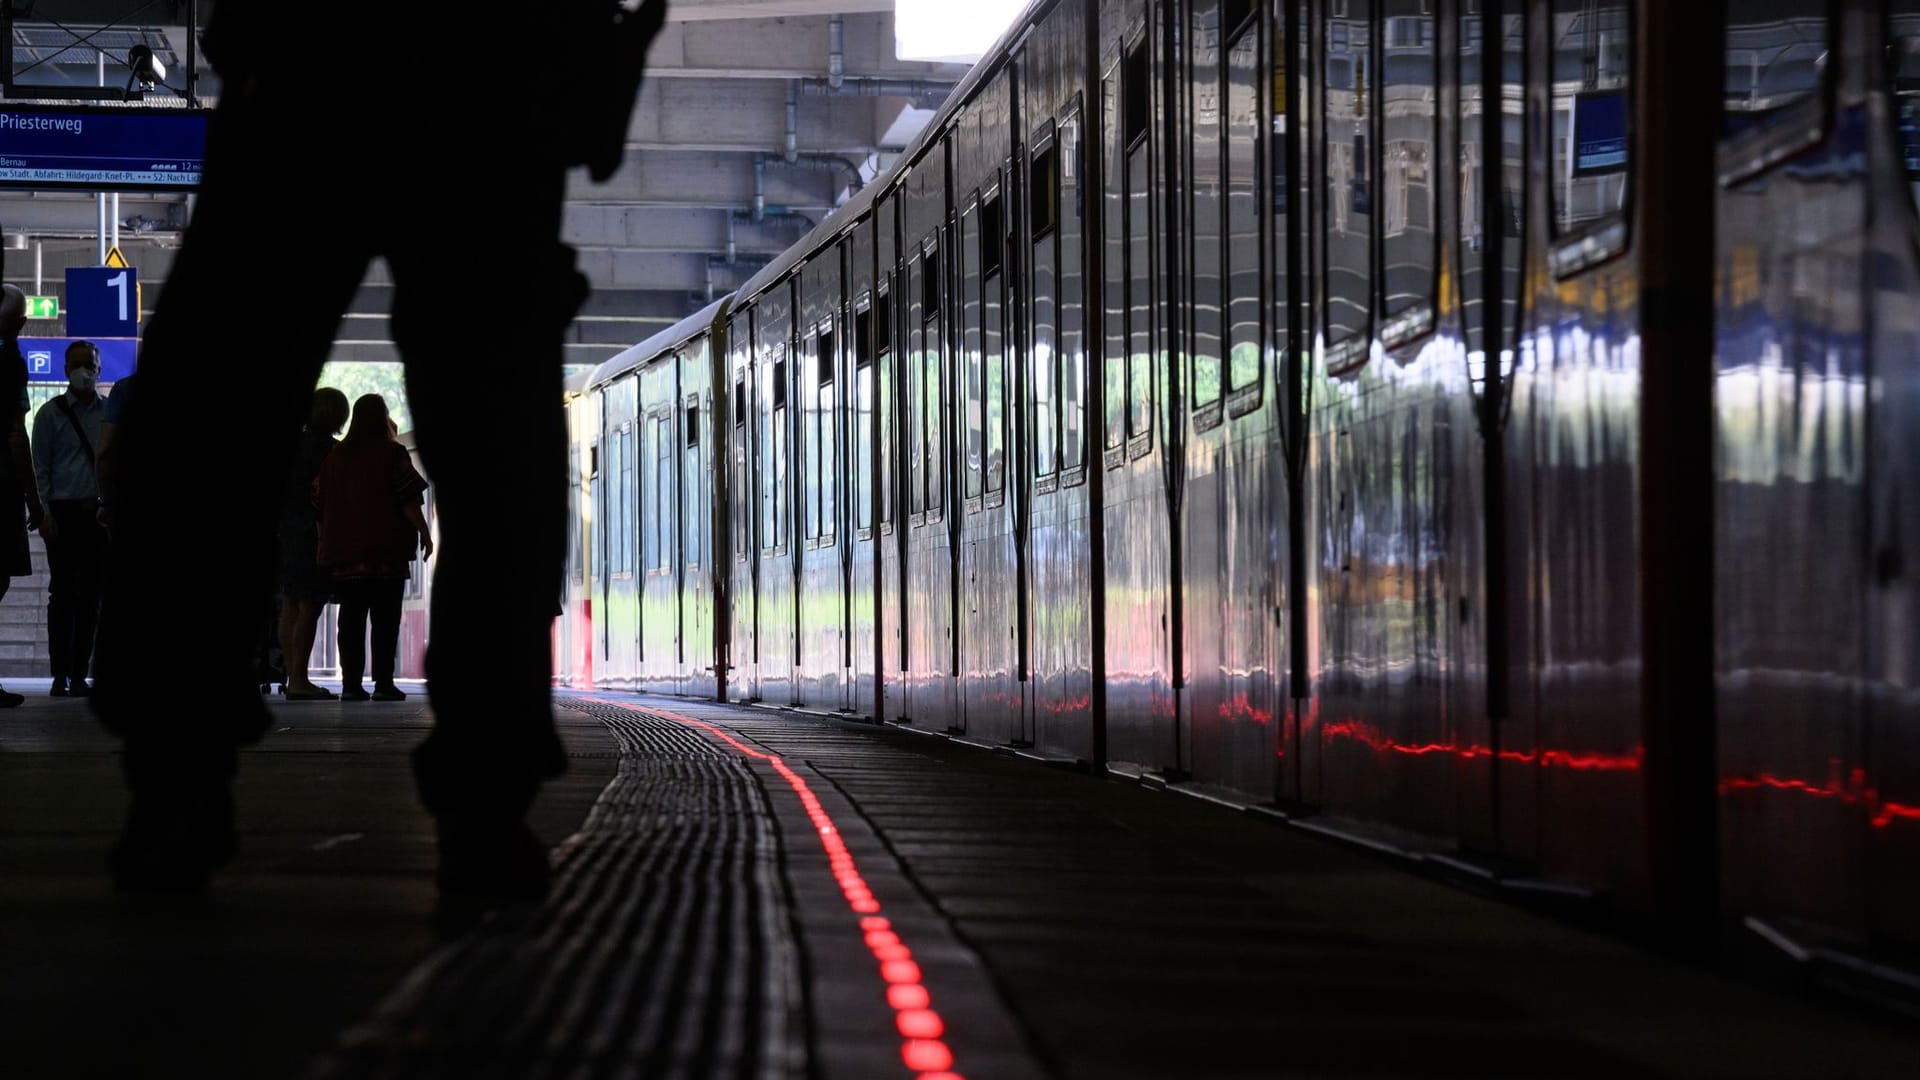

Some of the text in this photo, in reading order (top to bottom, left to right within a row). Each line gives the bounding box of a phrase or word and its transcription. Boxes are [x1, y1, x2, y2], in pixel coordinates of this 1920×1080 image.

[0, 113, 82, 135] Priesterweg
[0, 157, 27, 167] Bernau
[182, 162, 192, 171] 12
[33, 170, 65, 179] Abfahrt:
[167, 173, 185, 182] Nach
[106, 270, 128, 321] 1
